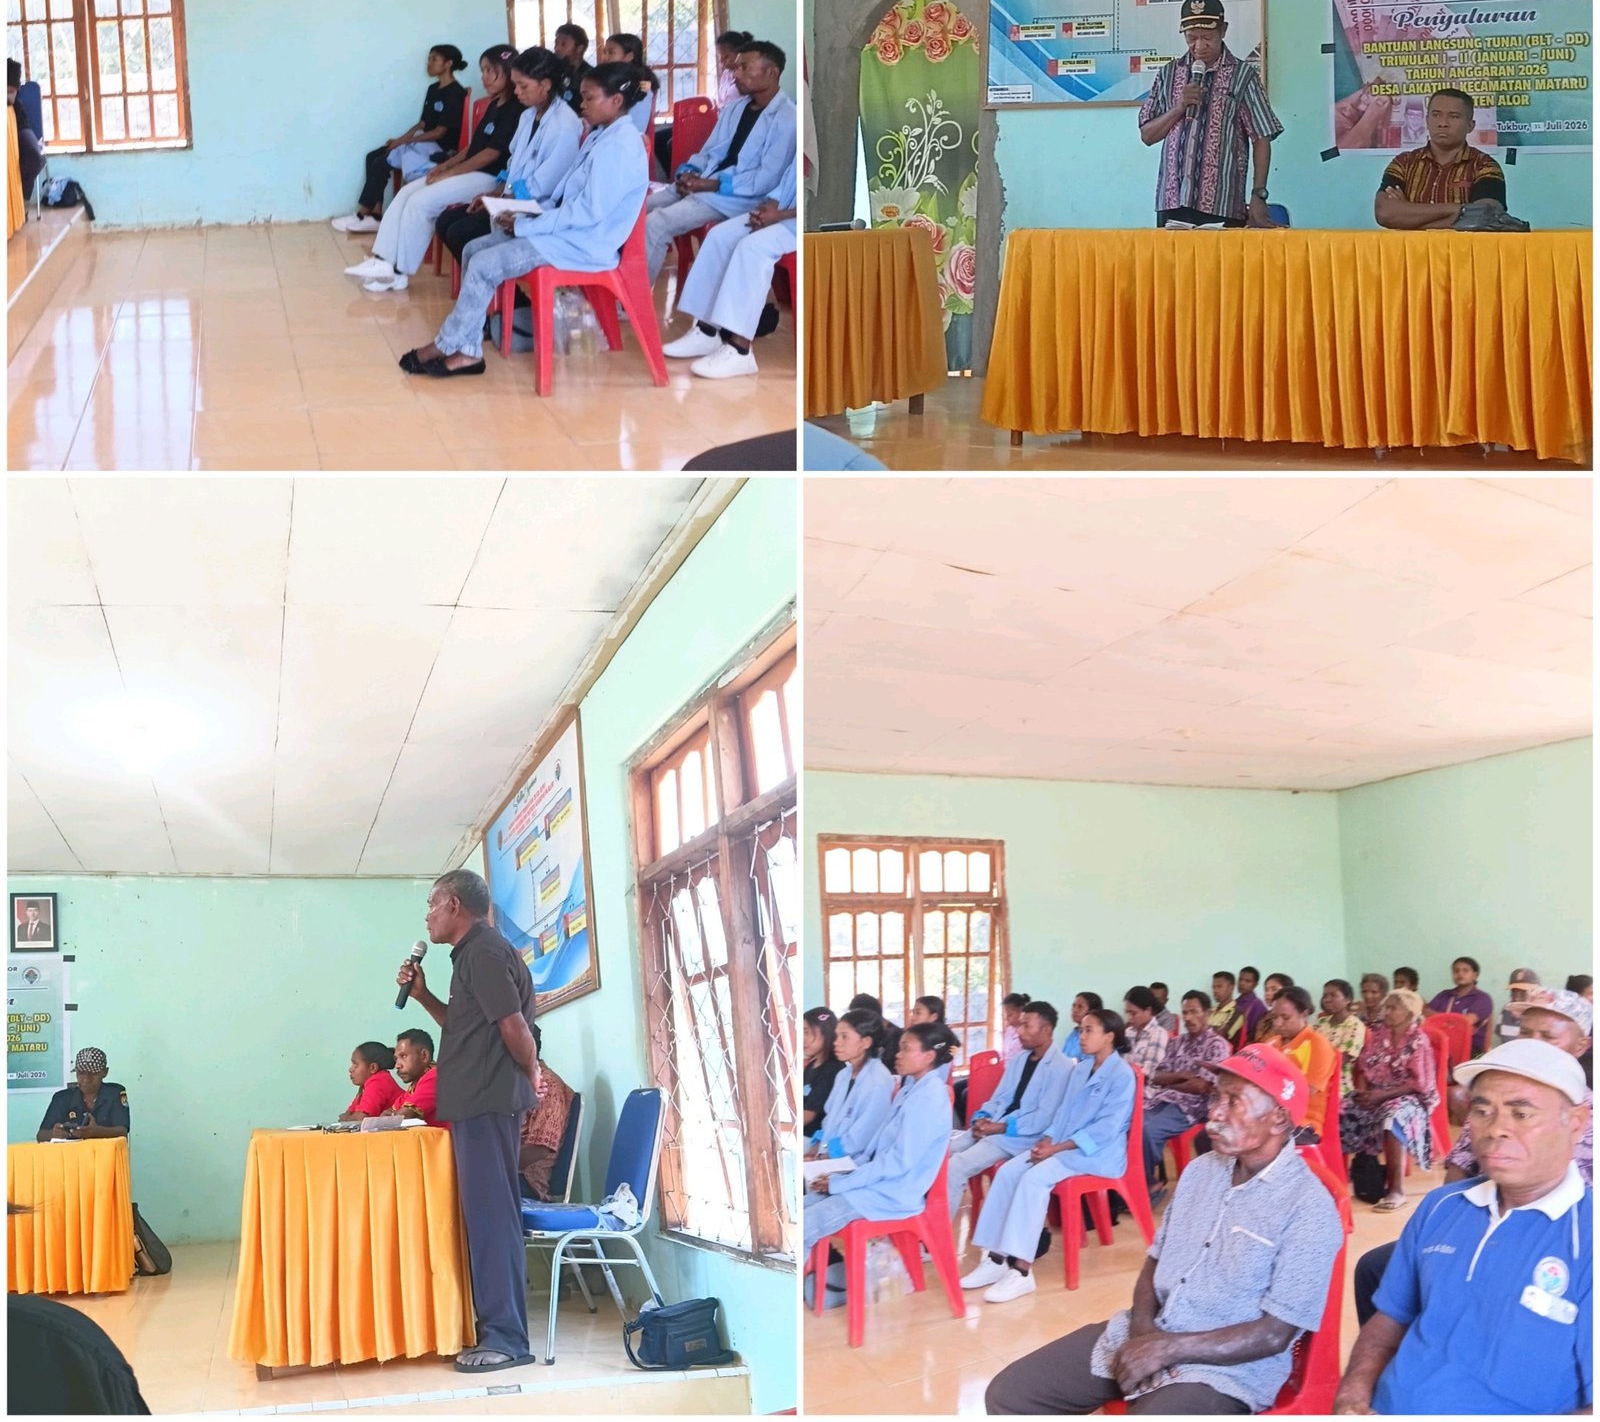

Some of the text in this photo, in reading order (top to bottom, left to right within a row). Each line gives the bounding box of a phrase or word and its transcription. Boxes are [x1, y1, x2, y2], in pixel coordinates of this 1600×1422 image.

[1394, 8, 1536, 32] Penyaluran
[1363, 41, 1416, 53] BANTUAN
[1420, 38, 1482, 51] LANGSUNG
[1485, 36, 1522, 48] TUNAI
[1526, 34, 1552, 48] (BLT
[1566, 33, 1590, 46] DD)
[1380, 54, 1438, 66] TRIWULAN
[1442, 54, 1446, 64] I
[1460, 52, 1468, 64] II
[1472, 50, 1528, 64] (JANUARI
[1542, 48, 1575, 61] JUNI)
[1406, 64, 1548, 80] TAHUN ANGGARAN 2026
[1372, 84, 1400, 95] DESA
[1460, 80, 1530, 92] KECAMATAN
[1535, 78, 1587, 90] MATARU
[1498, 94, 1530, 106] ALOR
[1496, 122, 1530, 131] Tukbur,
[1546, 122, 1562, 130] Juli
[1564, 121, 1588, 130] 2026
[34, 1014, 50, 1022] DD)
[12, 1043, 47, 1052] MATARU
